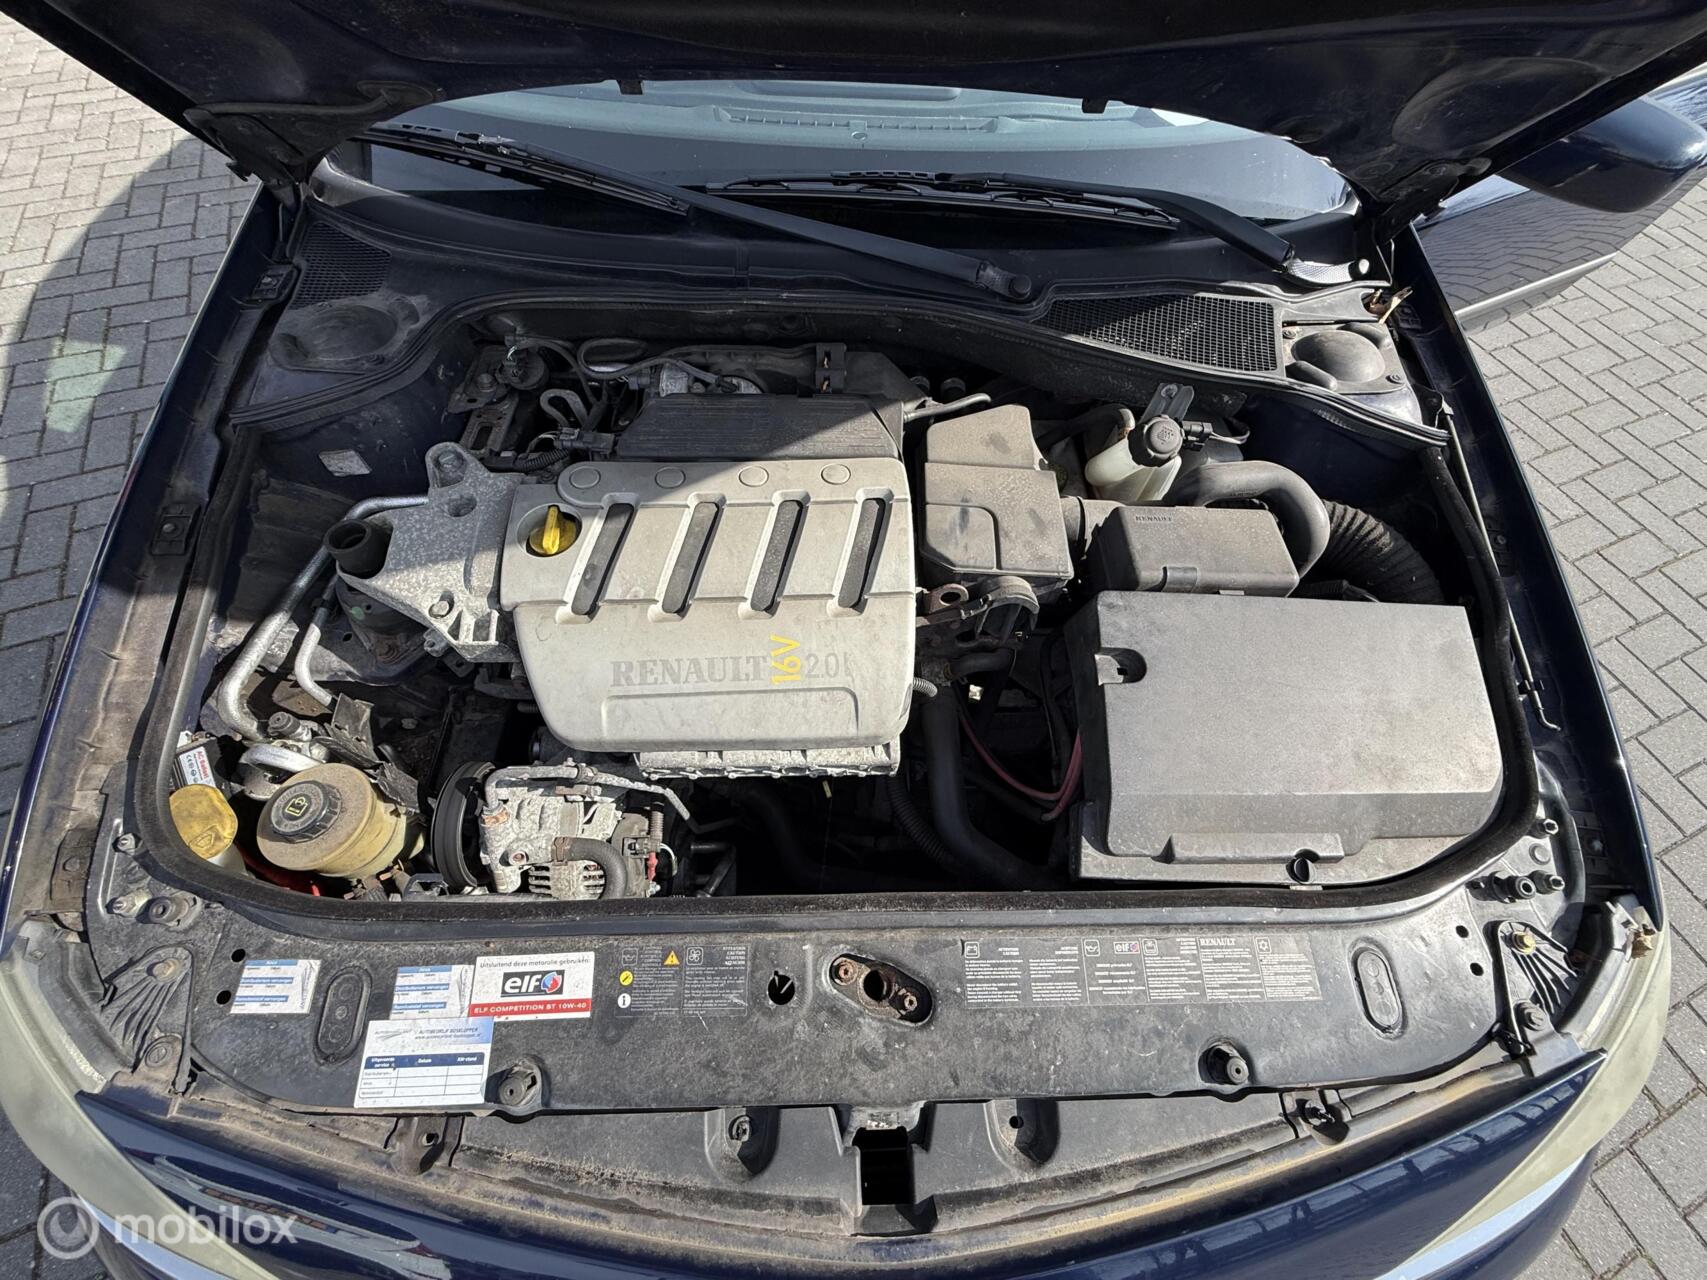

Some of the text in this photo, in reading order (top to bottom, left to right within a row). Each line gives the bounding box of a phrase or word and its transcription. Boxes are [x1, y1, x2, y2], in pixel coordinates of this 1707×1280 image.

[610, 655, 768, 688] RENAULT
[770, 634, 801, 685] 16V
[1199, 938, 1237, 946] RENAULT
[1115, 944, 1130, 952] elf
[480, 960, 512, 968] Uitsluitend
[504, 974, 543, 993] elf
[474, 1006, 488, 1014] ELF
[489, 1004, 544, 1013] COMPETITION
[558, 1002, 587, 1010] 10W-40
